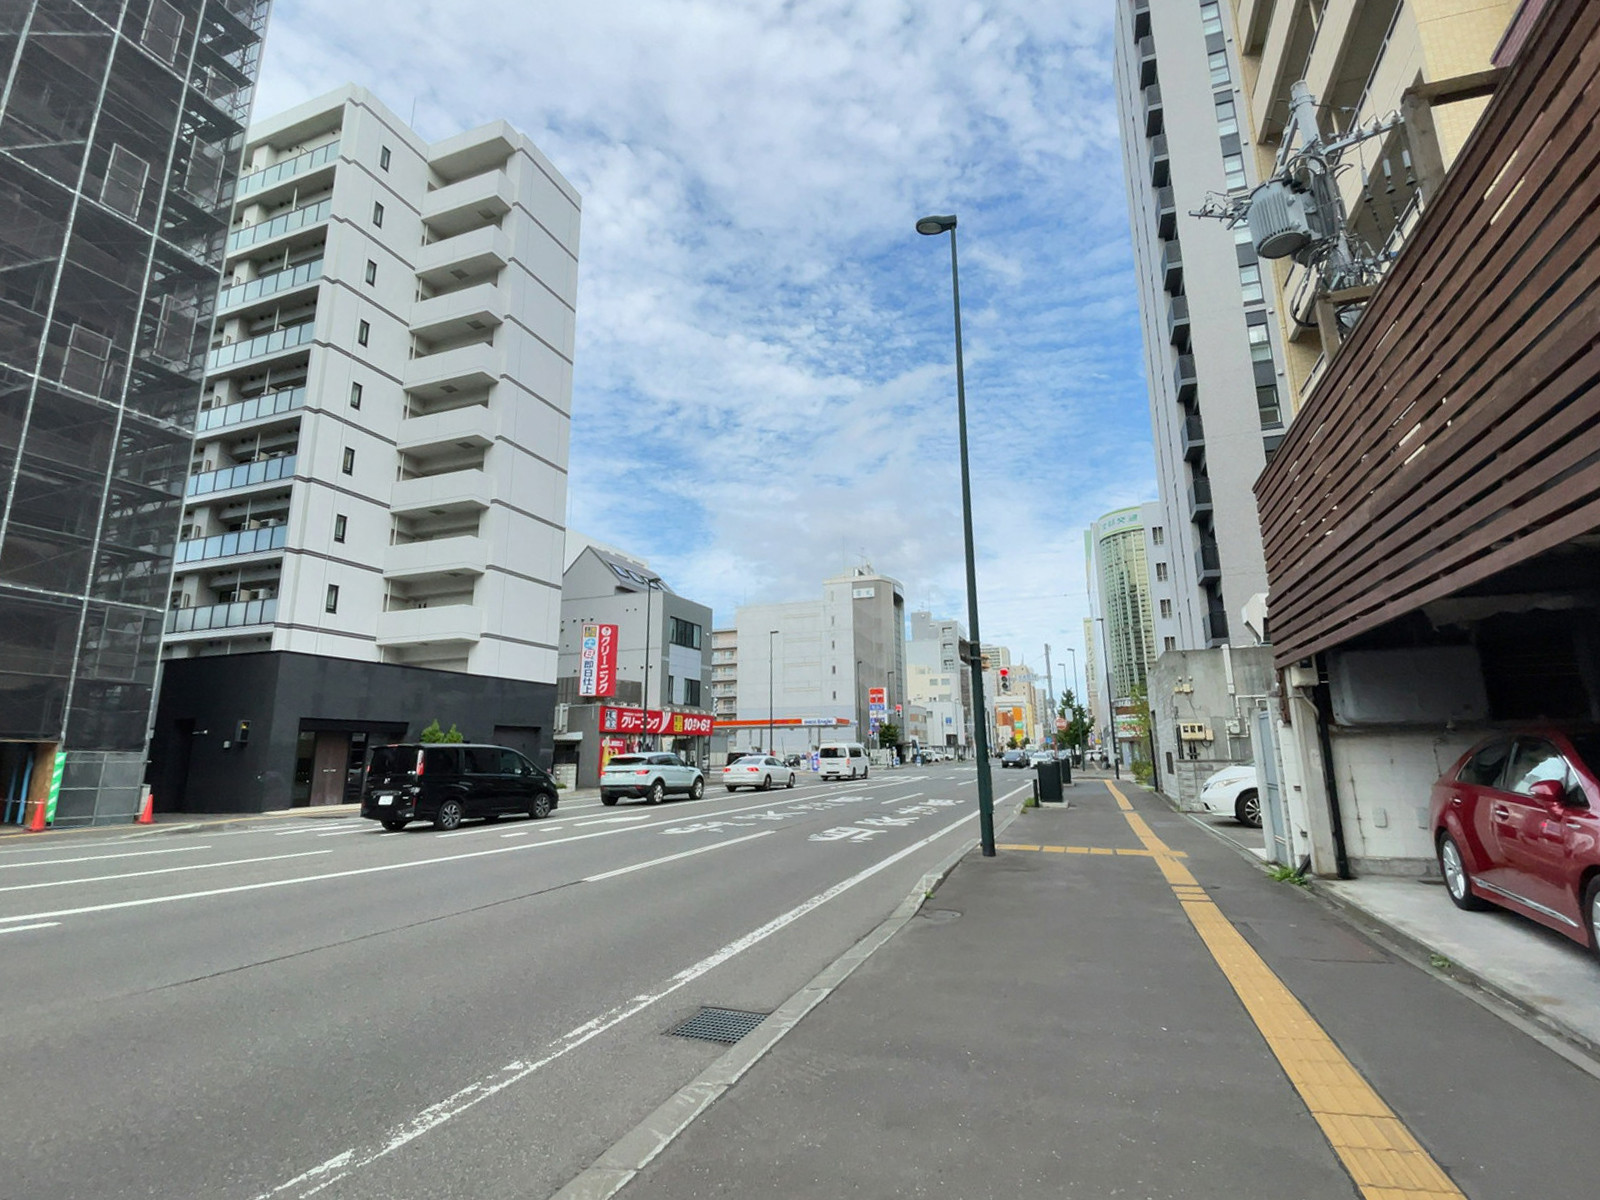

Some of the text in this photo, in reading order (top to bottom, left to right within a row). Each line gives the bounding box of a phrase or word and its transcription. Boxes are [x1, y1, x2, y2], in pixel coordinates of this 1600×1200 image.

[582, 660, 594, 694] 即日仕上
[598, 636, 611, 694] クリーニング
[621, 716, 660, 729] クリーニング
[684, 717, 693, 731] 10
